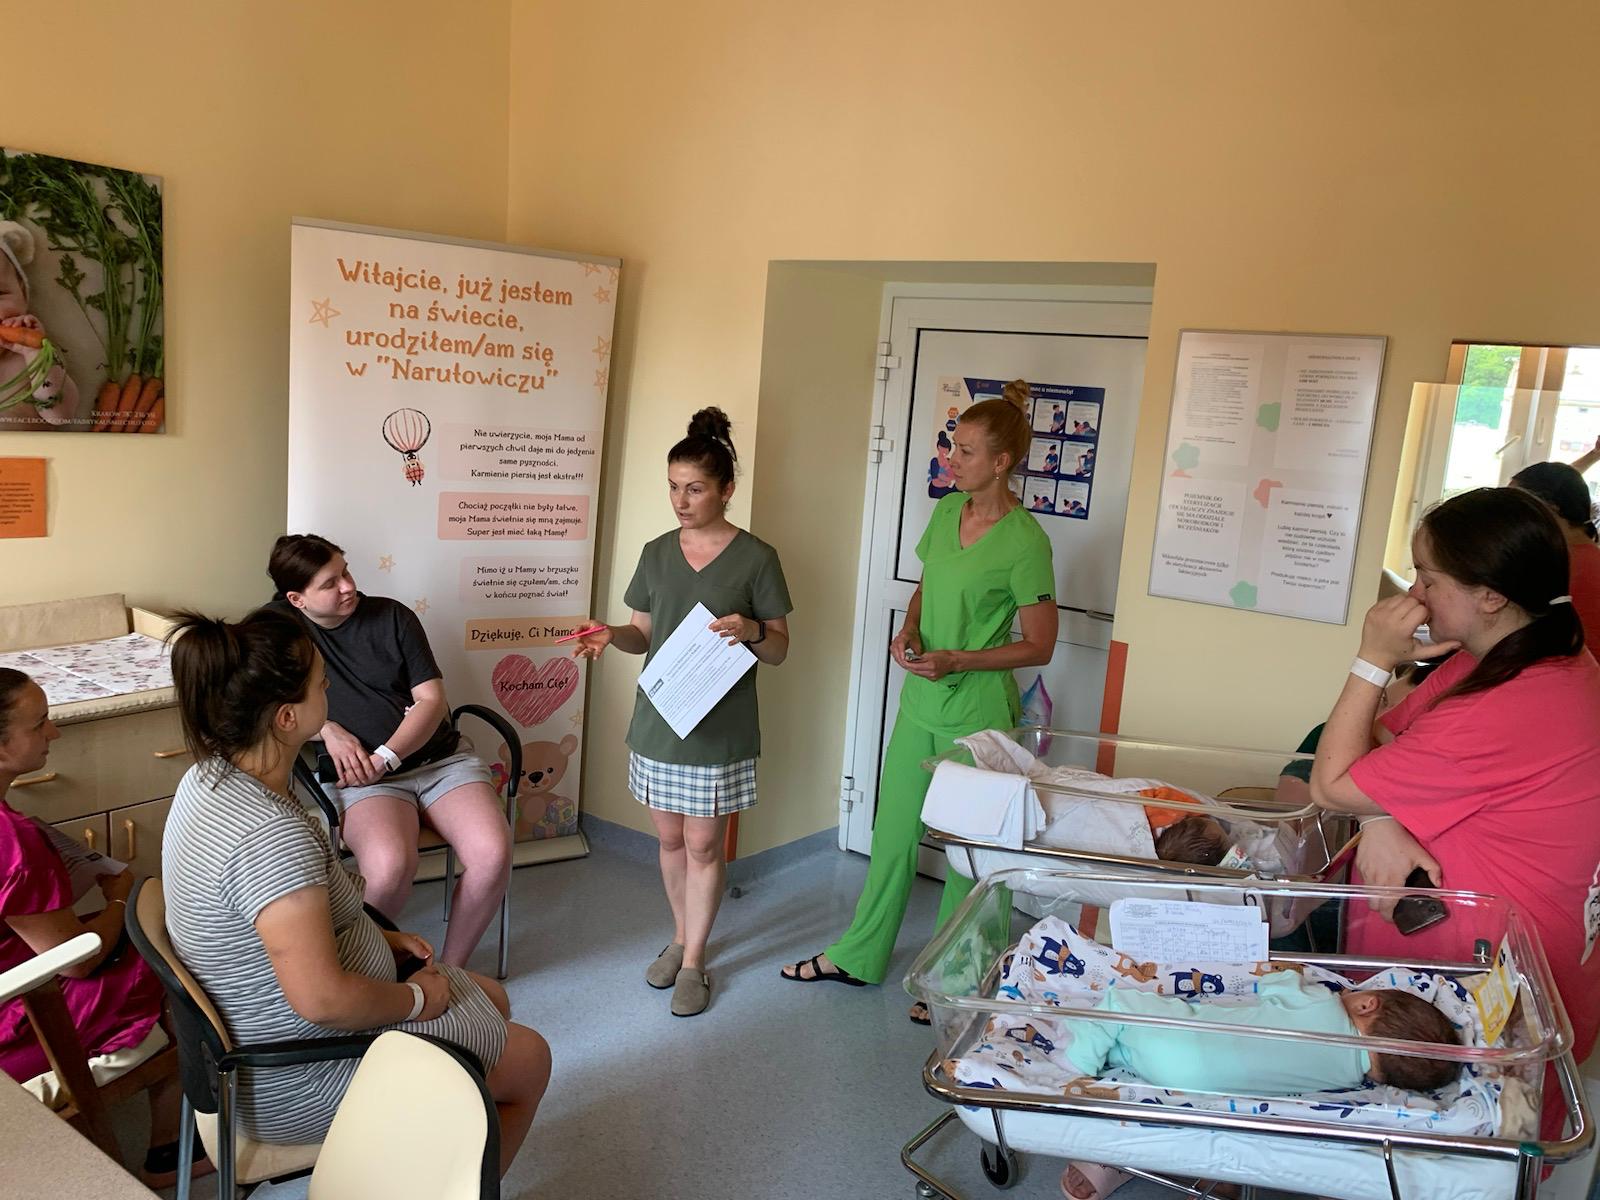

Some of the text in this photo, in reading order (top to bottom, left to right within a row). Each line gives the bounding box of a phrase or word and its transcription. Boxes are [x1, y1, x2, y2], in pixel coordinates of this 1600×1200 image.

[337, 258, 573, 305] Witajcie, już jestem
[389, 301, 524, 332] na świecie,
[346, 328, 554, 367] urodziłem/am się
[346, 356, 558, 393] w "Narutowiczu"
[474, 430, 487, 438] Nie
[554, 434, 574, 442] Mama
[460, 444, 503, 452] pierwszych
[506, 444, 525, 452] chwil
[528, 446, 543, 454] daje
[567, 448, 595, 456] jedzenia
[471, 470, 509, 478] Karmienie
[511, 471, 536, 480] piersią
[538, 472, 551, 480] jest
[459, 502, 488, 511] Chociaż
[490, 502, 521, 512] początki
[538, 503, 554, 512] były
[467, 528, 568, 537] Super jest mieć taką Mamę!
[477, 566, 497, 574] Mimo
[500, 566, 506, 574] iż
[515, 566, 537, 574] Mamy
[547, 566, 578, 574] brzuszku
[473, 578, 504, 586] świetnie
[562, 578, 578, 586] chcę
[519, 591, 544, 599] poznać
[528, 627, 539, 638] Ci
[500, 677, 569, 692] Kocham Cię!
